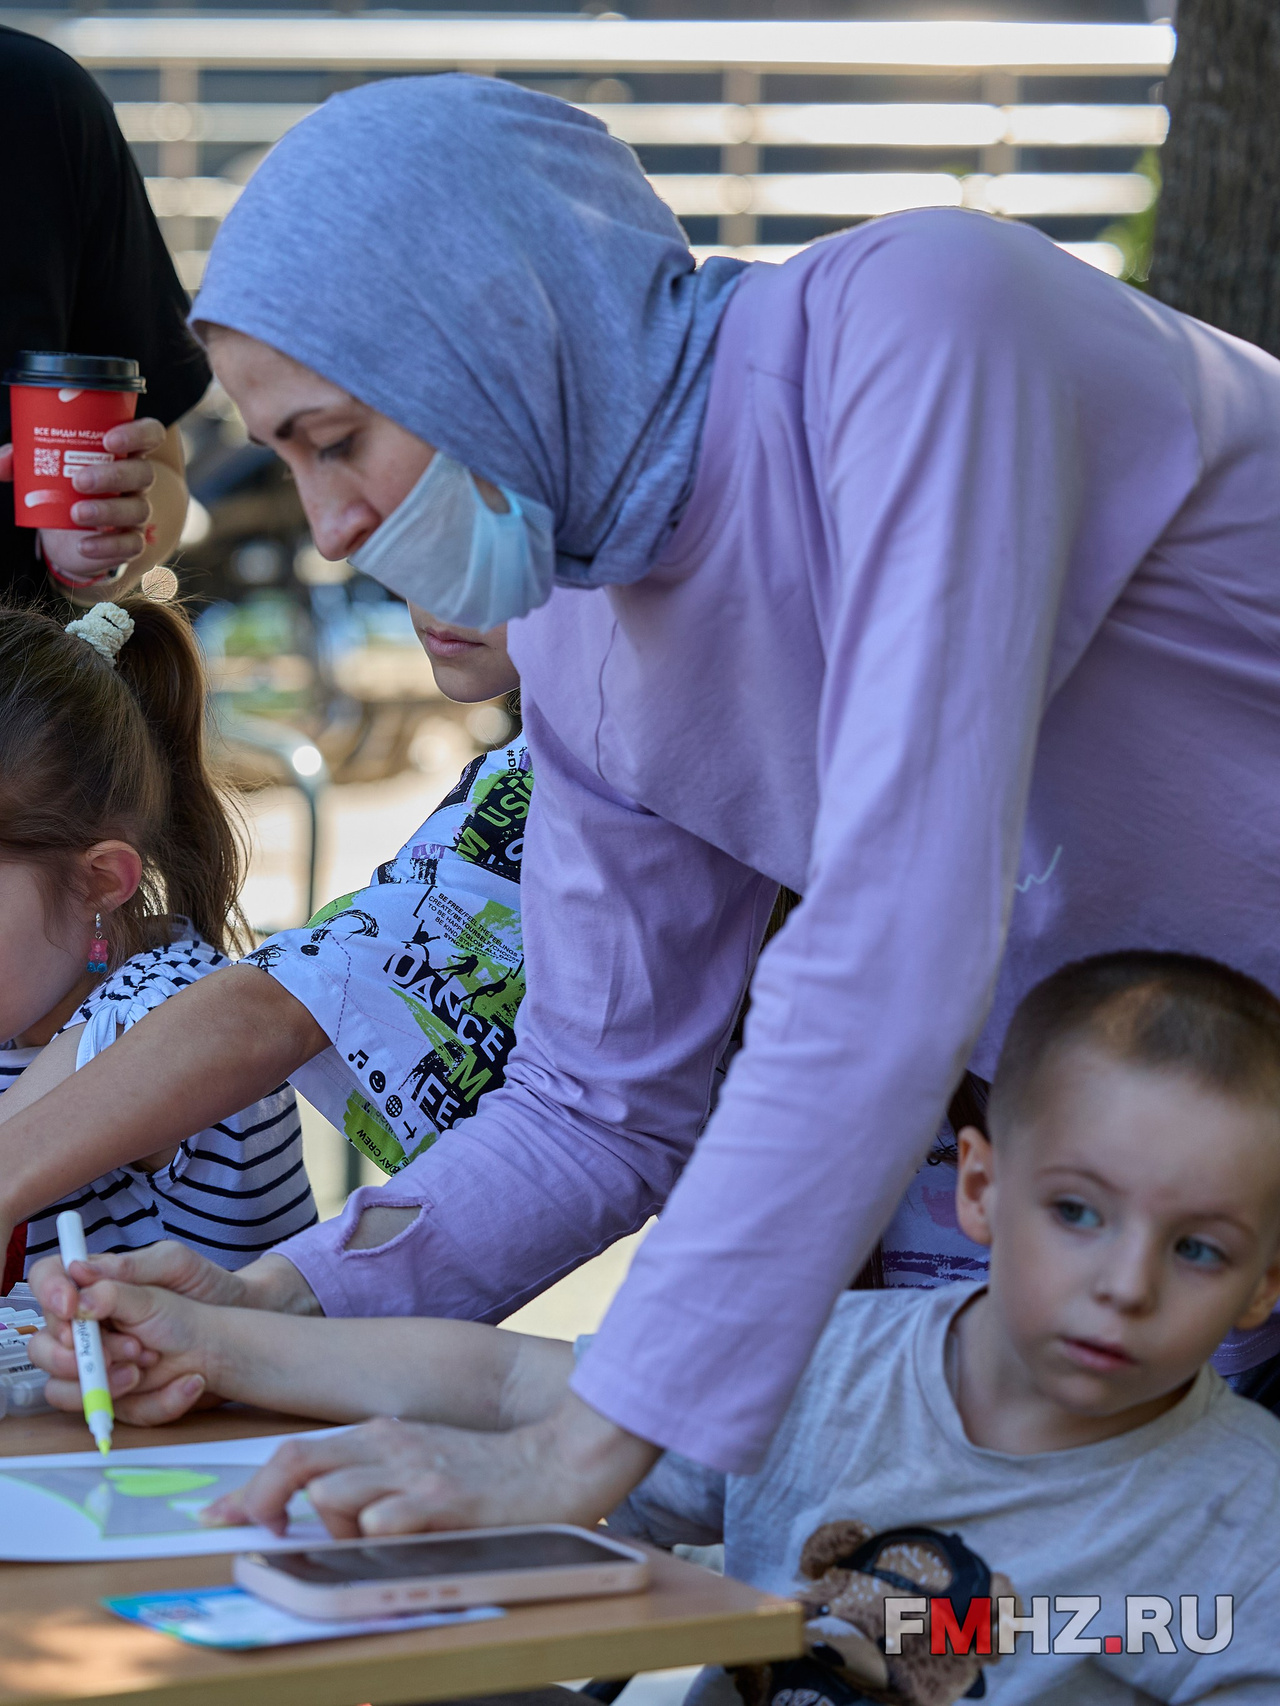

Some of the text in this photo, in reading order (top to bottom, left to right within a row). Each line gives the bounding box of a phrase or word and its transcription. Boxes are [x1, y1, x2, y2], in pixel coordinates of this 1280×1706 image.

[34, 427, 50, 436] ВСЕ
[51, 428, 77, 438] ВИДЫ
[428, 895, 521, 963] CREATE/BE YOURSELF/CHOOSE
[428, 903, 437, 912] TO
[438, 910, 447, 919] BE
[445, 916, 485, 949] HAPPY/GLOW
[485, 946, 498, 958] ALL
[434, 916, 444, 926] BE
[443, 922, 475, 949] KIND/STAY
[438, 893, 519, 957] BE FREE/FEEL THE FEELINGS
[389, 952, 505, 1062] DANCE
[356, 1129, 381, 1157] CREW
